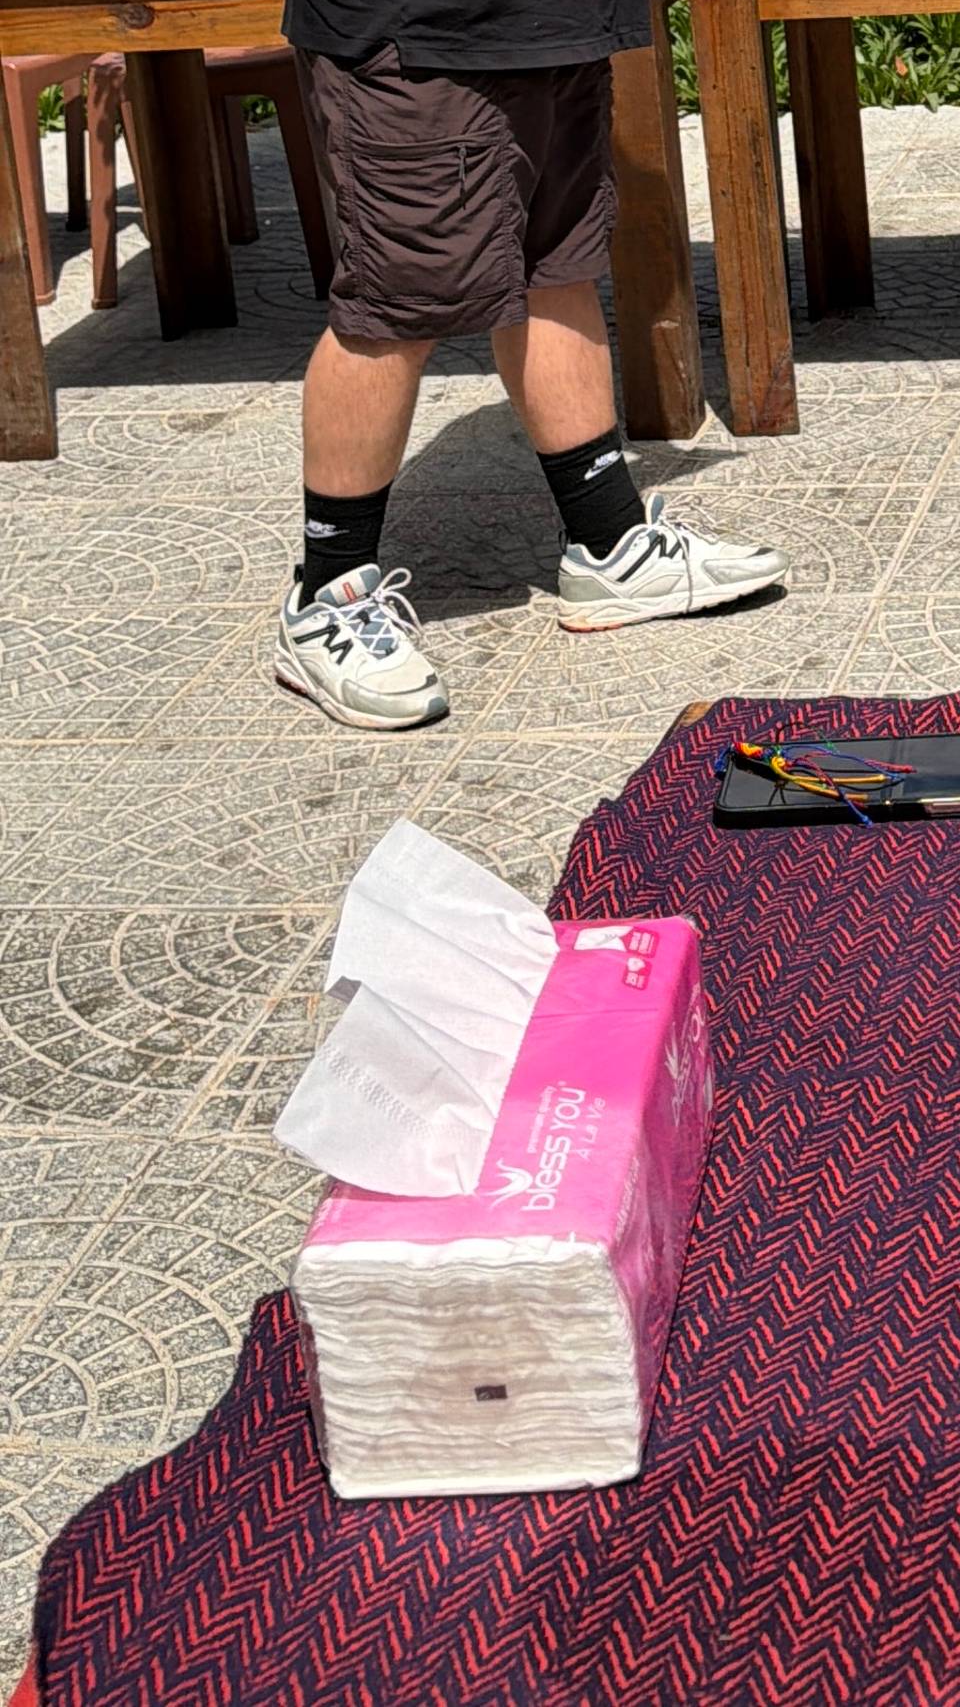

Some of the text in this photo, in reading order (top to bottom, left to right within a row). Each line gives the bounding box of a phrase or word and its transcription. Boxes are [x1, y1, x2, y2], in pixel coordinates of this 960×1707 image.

[520, 1087, 587, 1211] bless YOU
[581, 1124, 599, 1144] La
